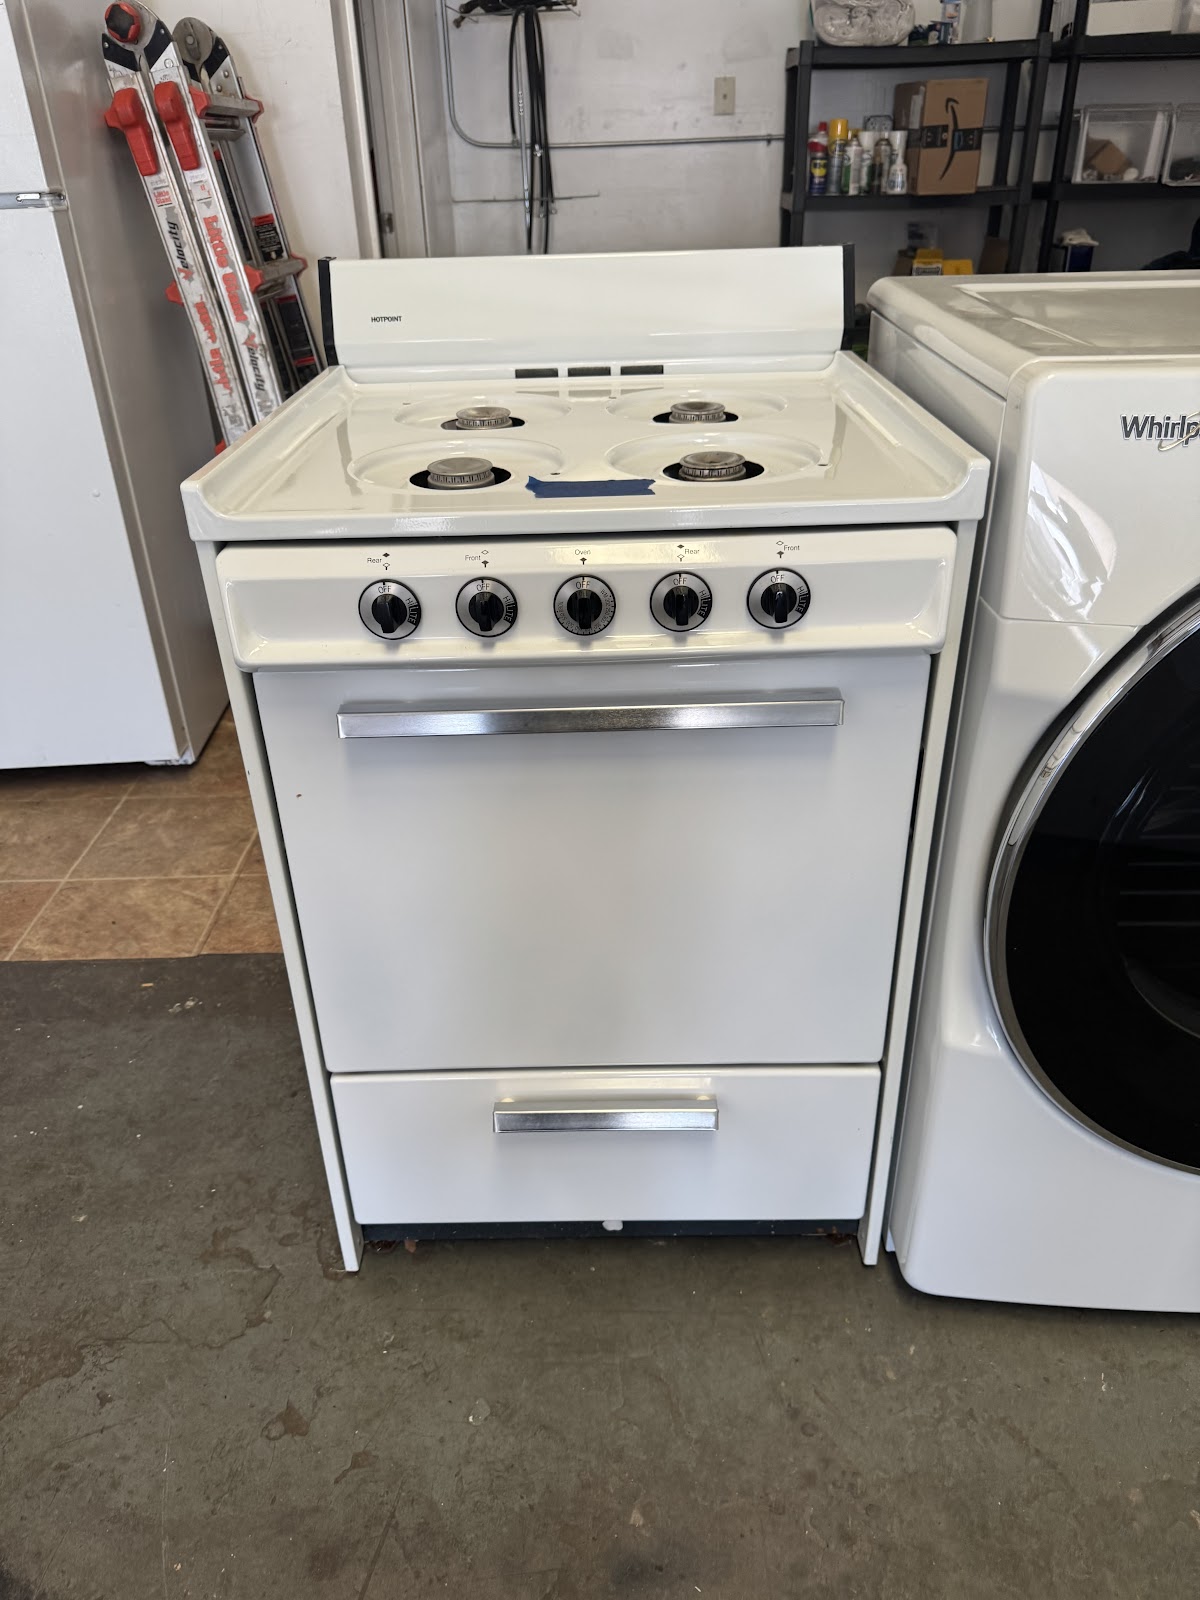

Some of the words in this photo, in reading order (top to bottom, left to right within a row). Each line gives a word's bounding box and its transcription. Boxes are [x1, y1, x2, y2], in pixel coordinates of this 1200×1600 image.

[167, 221, 195, 281] Velocity
[203, 215, 229, 268] Little
[222, 272, 248, 322] Giant
[243, 332, 266, 392] Velocity
[371, 315, 402, 323] HOTPOINT
[1120, 414, 1200, 447] Whirlp
[672, 577, 687, 586] OFF
[770, 574, 785, 584] OFF
[377, 585, 392, 594] OFF
[476, 583, 490, 592] OFF
[575, 580, 590, 590] OFF
